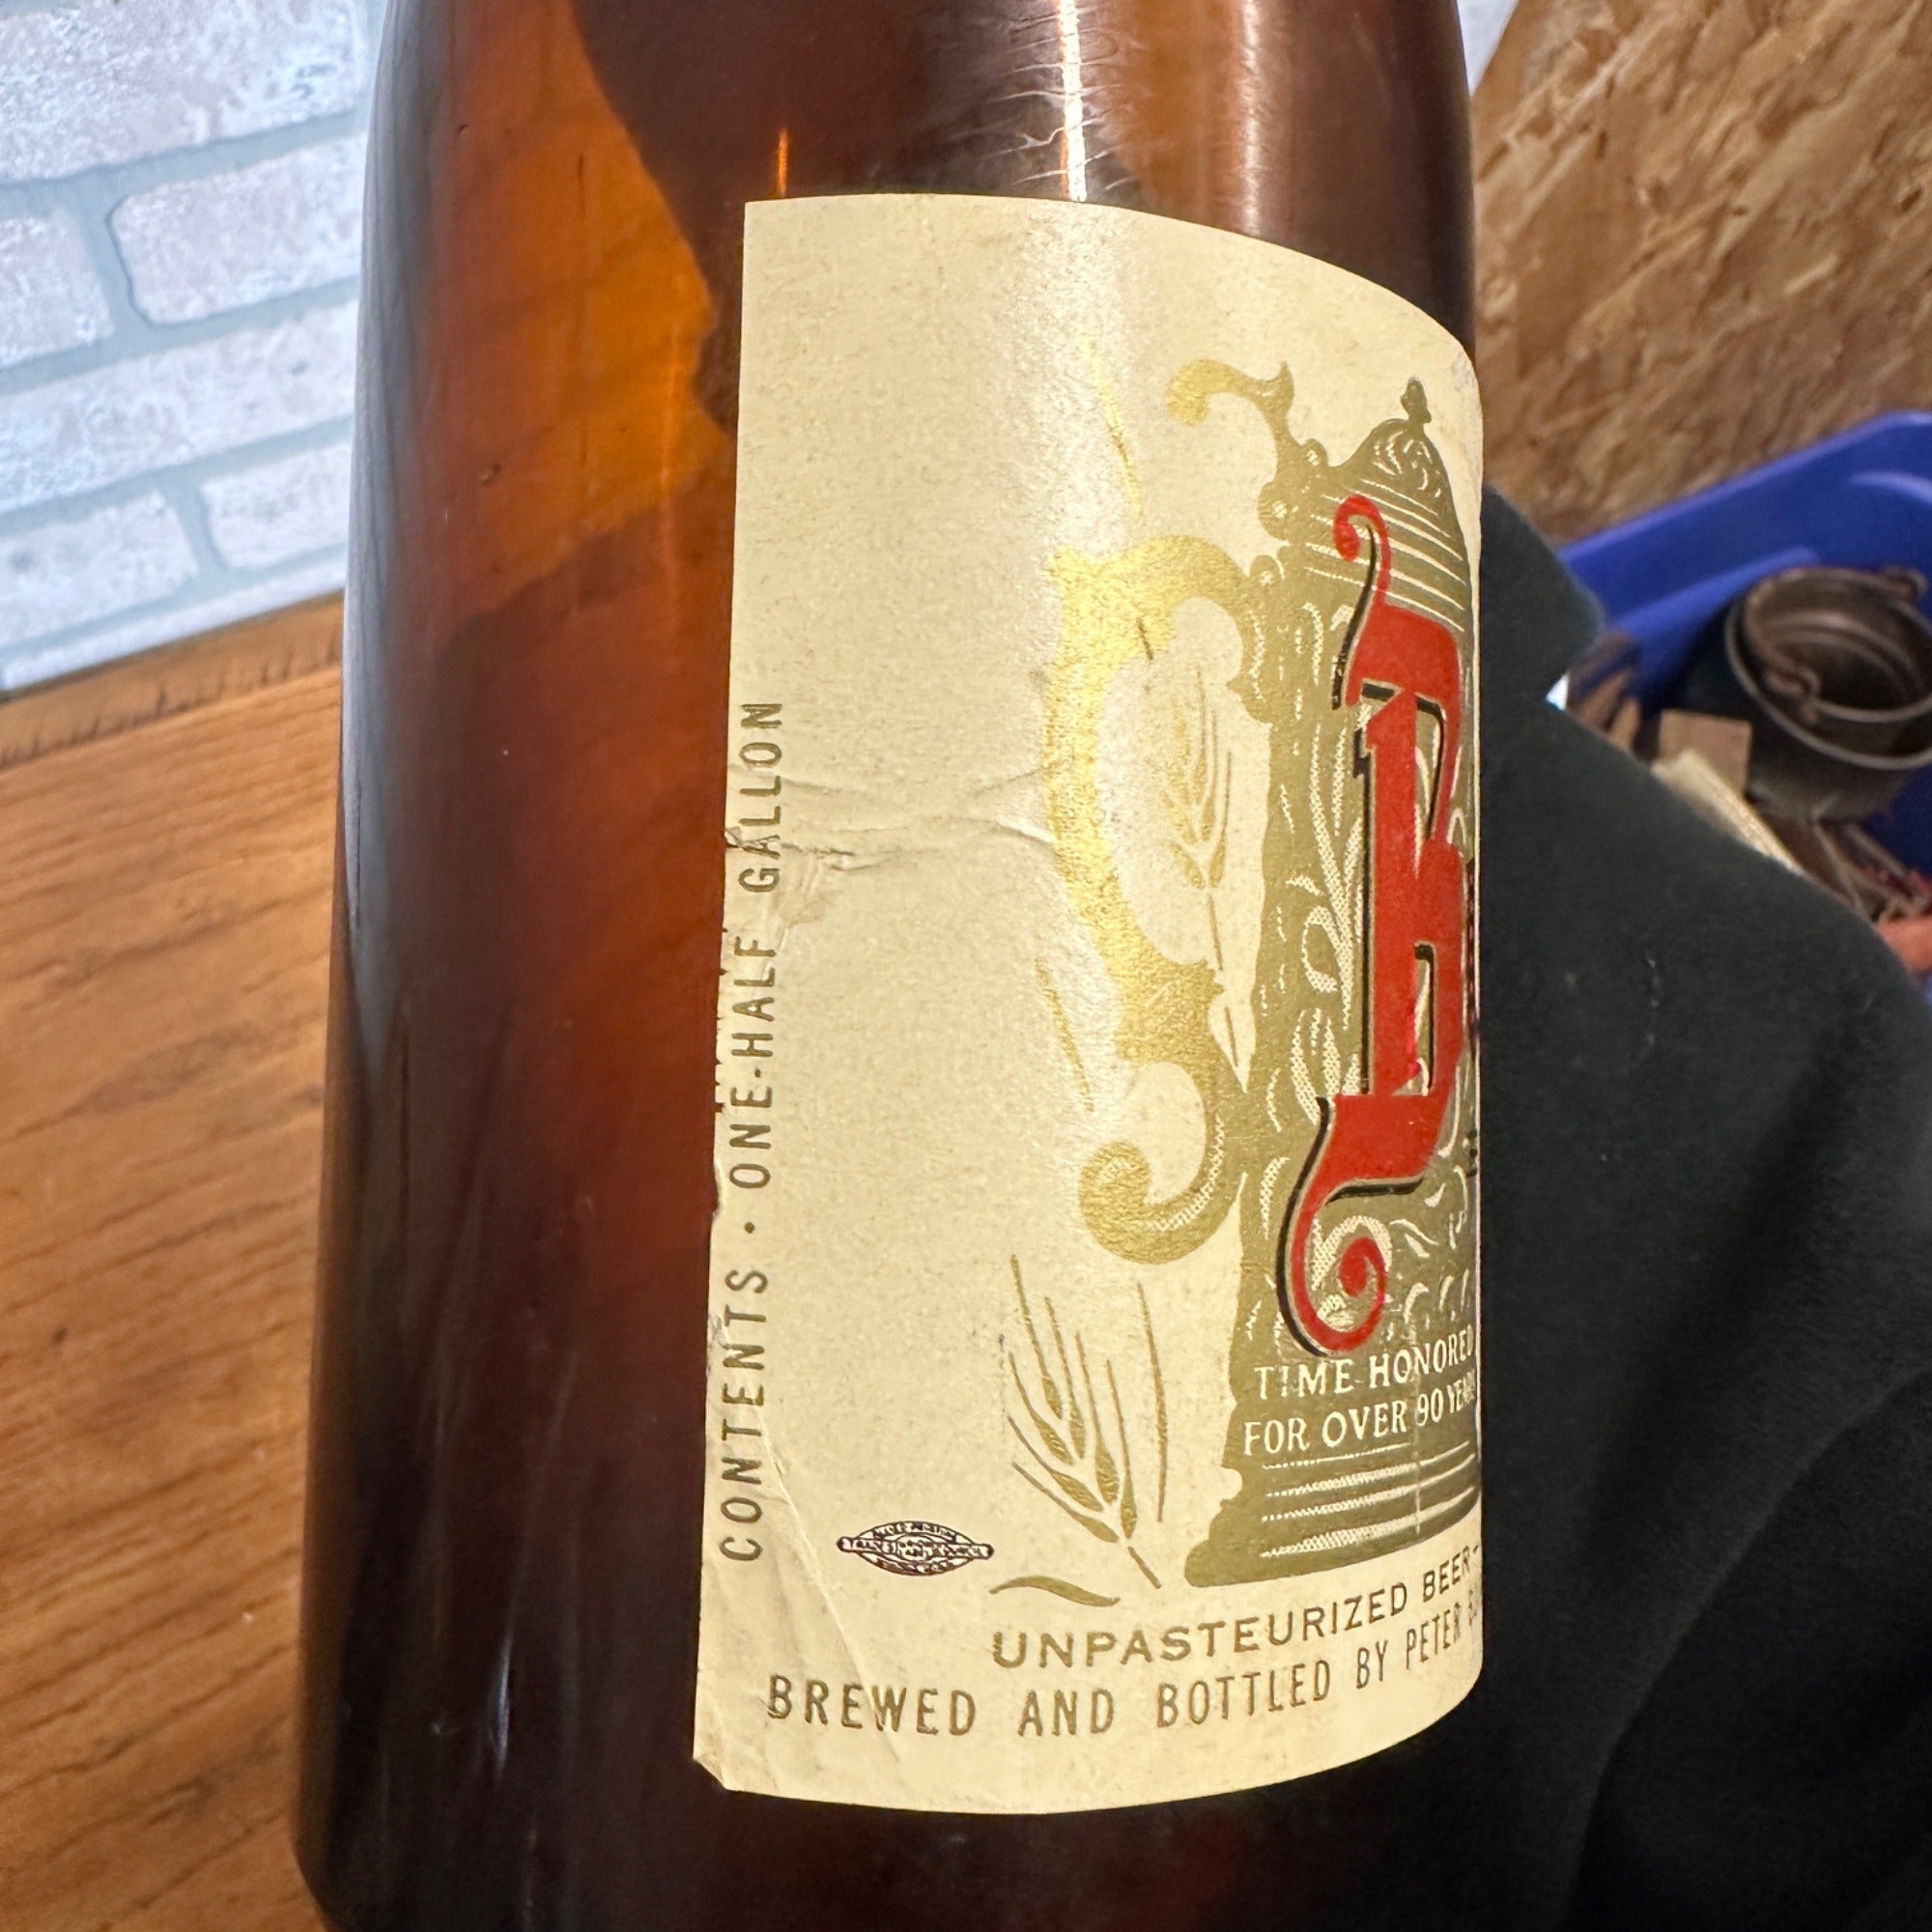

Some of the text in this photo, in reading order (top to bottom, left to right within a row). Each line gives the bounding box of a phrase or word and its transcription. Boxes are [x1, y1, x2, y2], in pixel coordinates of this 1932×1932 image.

[720, 702, 783, 1562] CONTENTS ONE-HALF GALLON
[1243, 1416, 1311, 1456] FOR
[1321, 1400, 1408, 1448] OVER
[1415, 1387, 1444, 1427] 90
[1254, 1357, 1354, 1401] TIME
[992, 1581, 1408, 1668] UNPASTEURIZED
[767, 1674, 977, 1736] BREWED
[1017, 1689, 1115, 1737] AND
[1155, 1659, 1331, 1728] BOTTLED
[1355, 1639, 1388, 1690] BY
[1405, 1601, 1463, 1670] PETER
